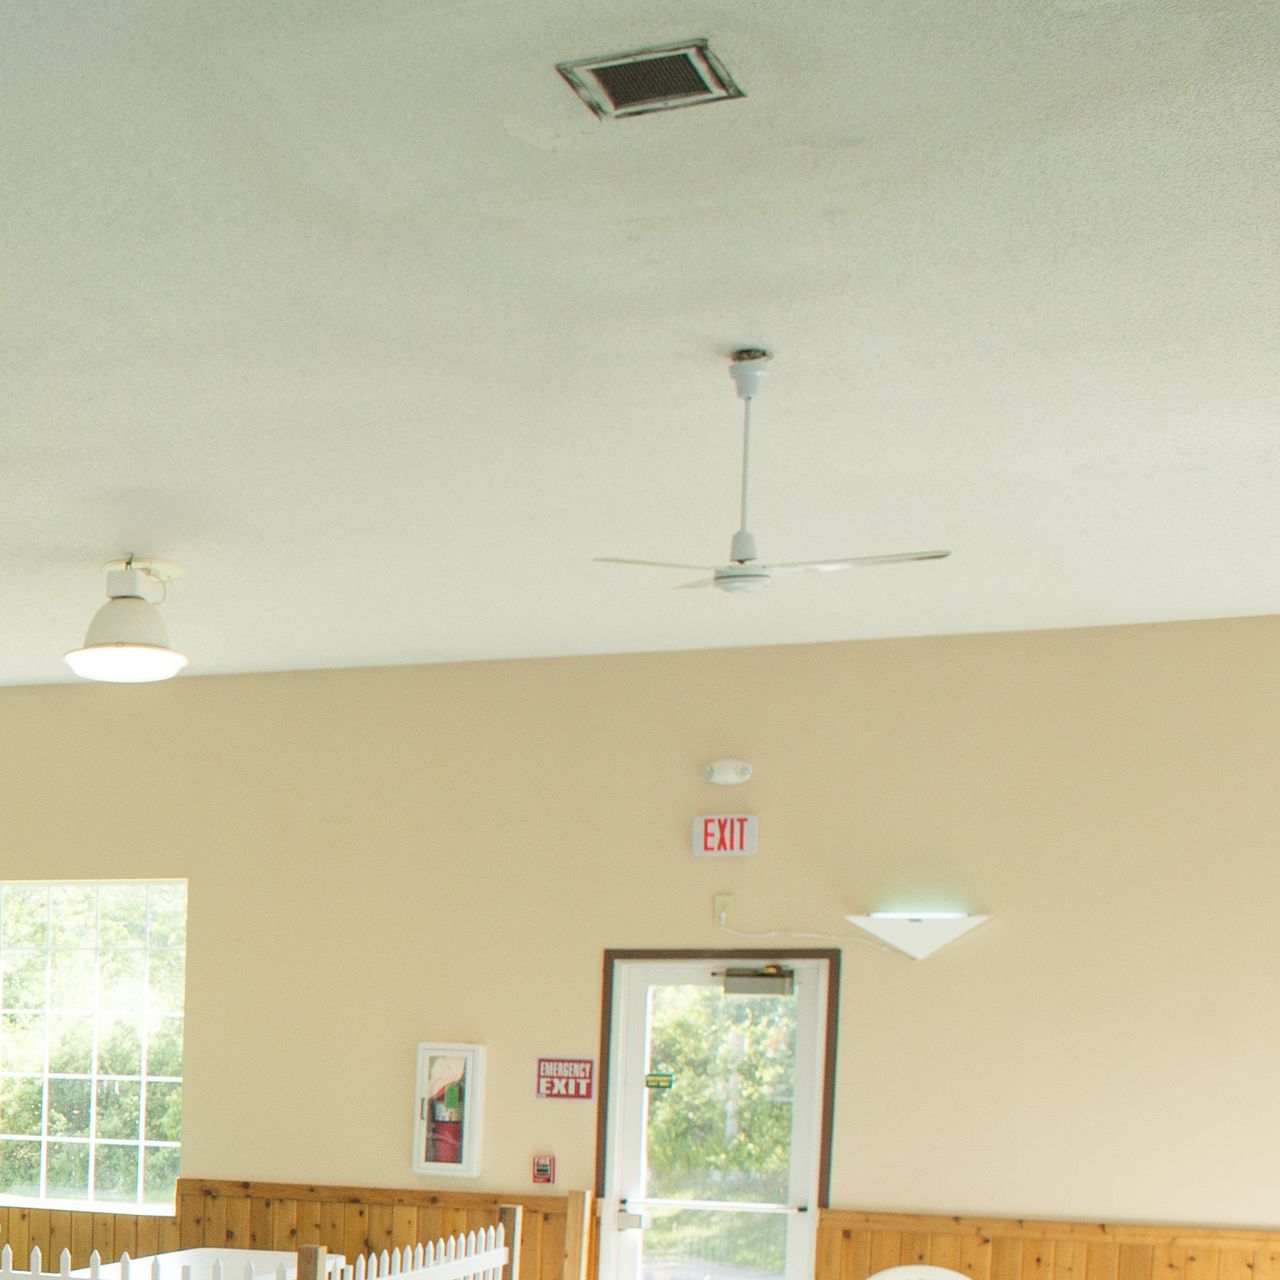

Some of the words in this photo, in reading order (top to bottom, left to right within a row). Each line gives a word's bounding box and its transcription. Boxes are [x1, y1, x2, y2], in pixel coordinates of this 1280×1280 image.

[704, 818, 748, 851] EXIT
[540, 1061, 591, 1078] EMERGENCY
[540, 1078, 590, 1096] EXIT
